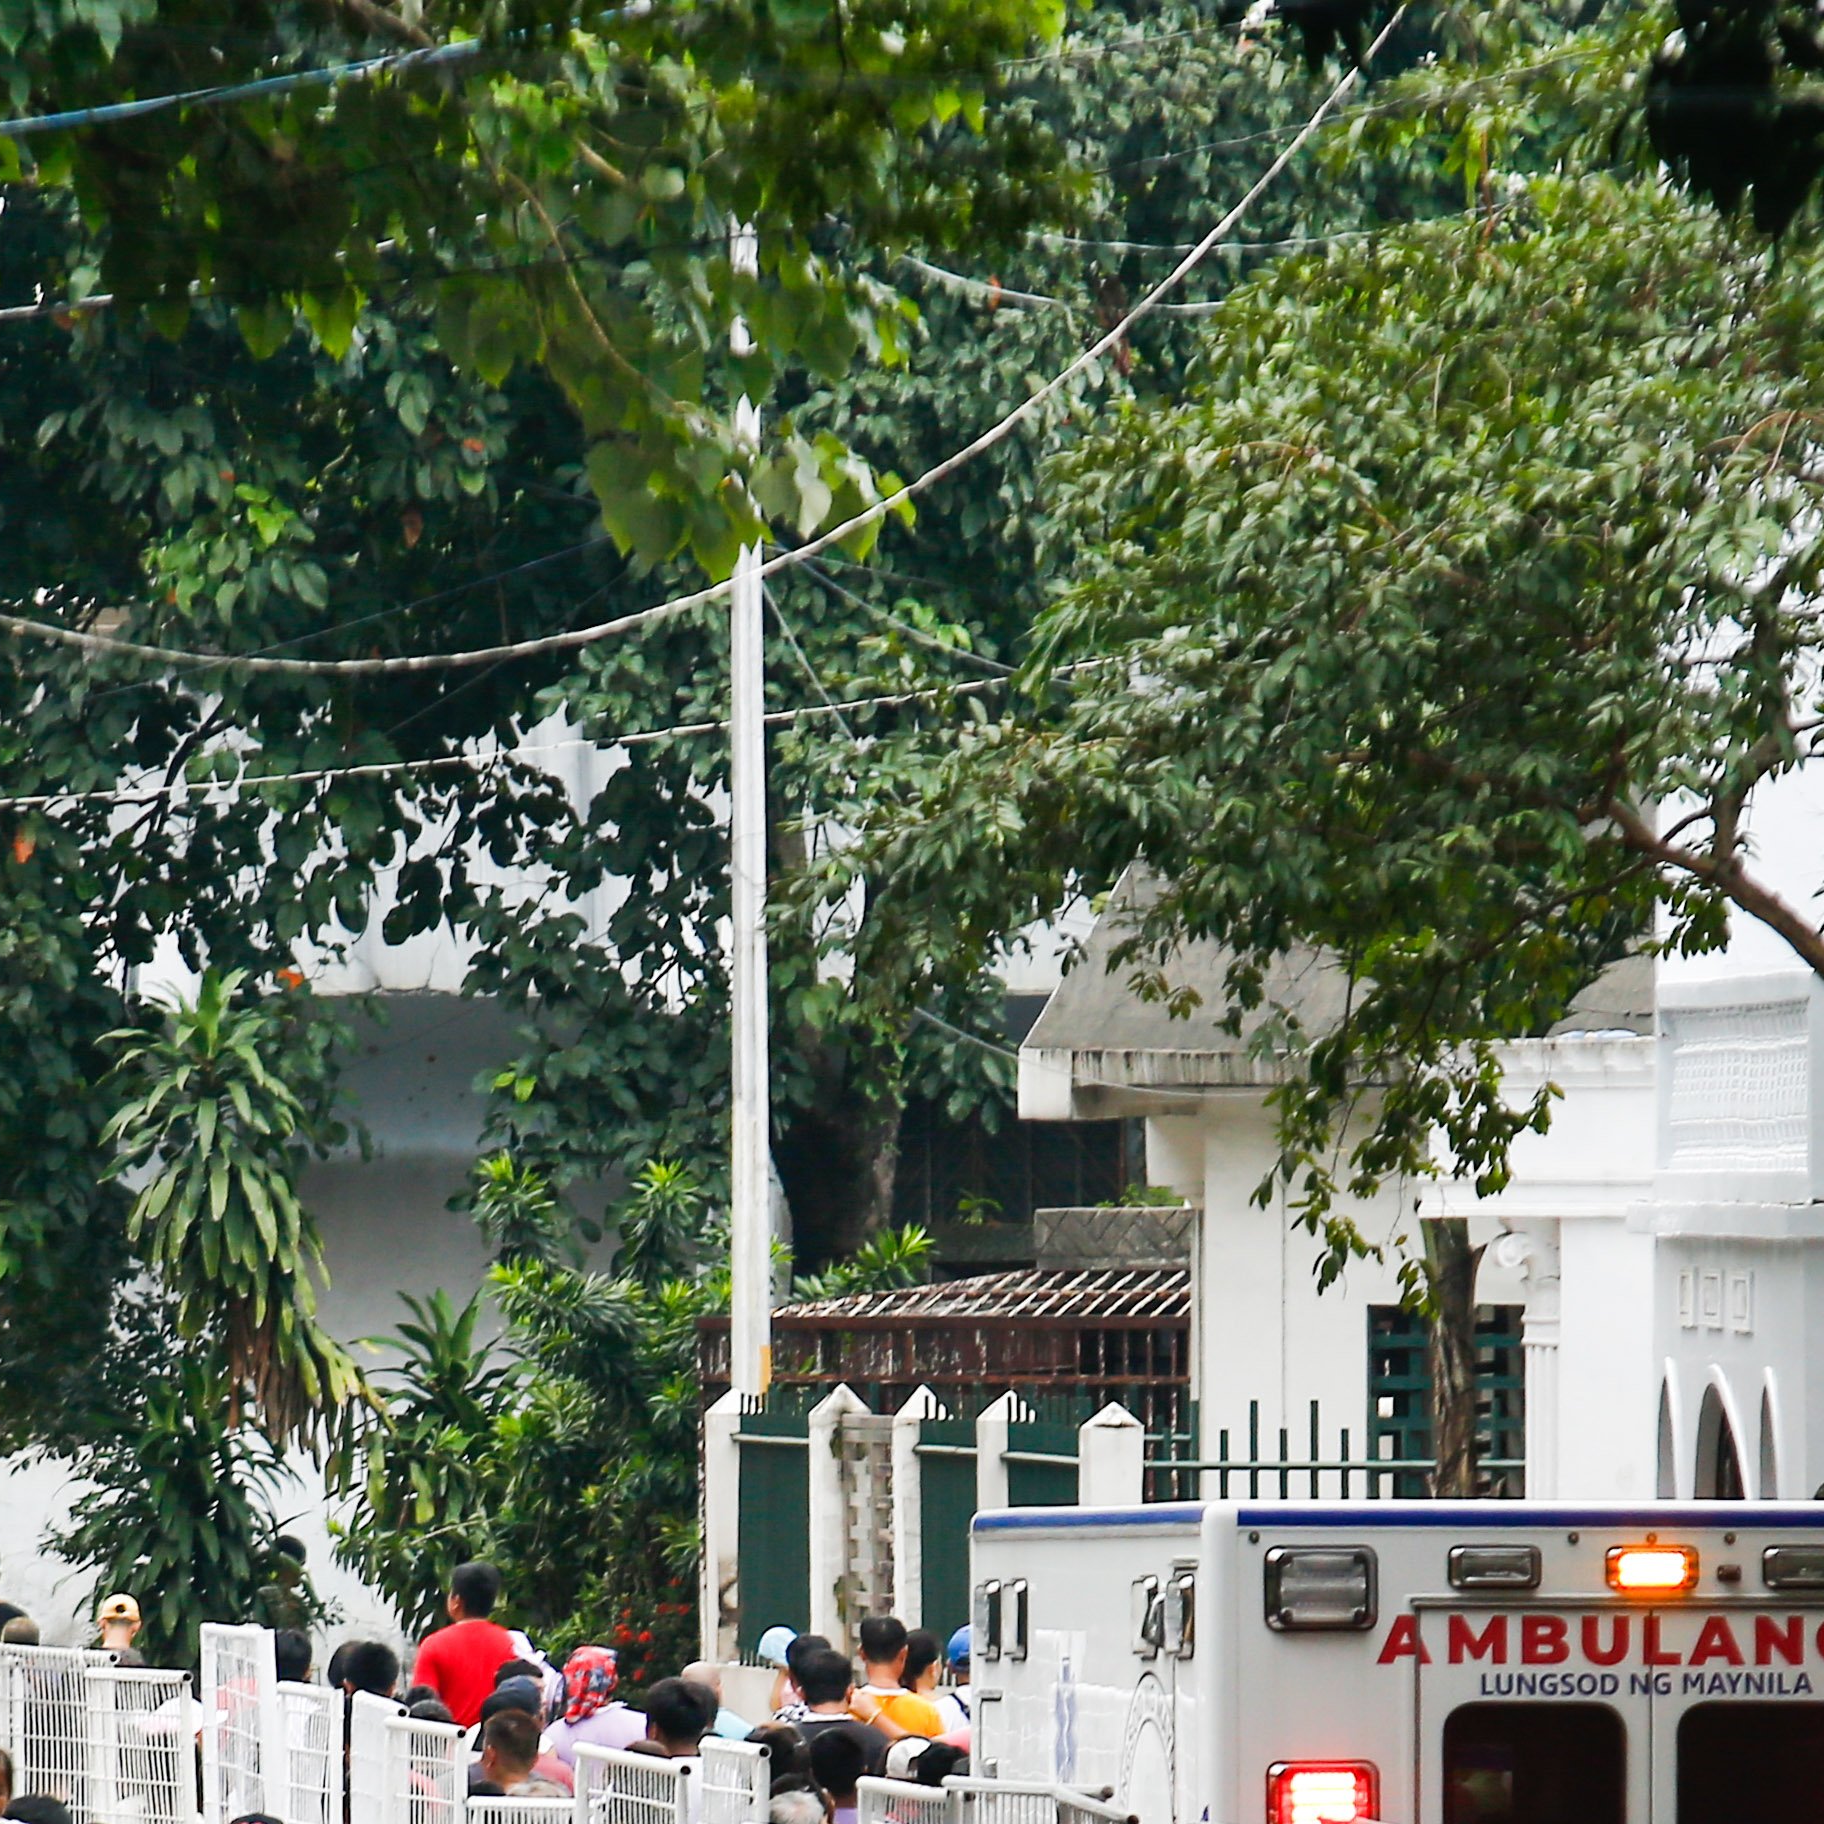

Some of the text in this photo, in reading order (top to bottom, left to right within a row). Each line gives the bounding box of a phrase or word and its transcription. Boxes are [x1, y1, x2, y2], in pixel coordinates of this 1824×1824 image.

[1480, 1671, 1813, 1697] LUNGSOD NG MAYNILA
